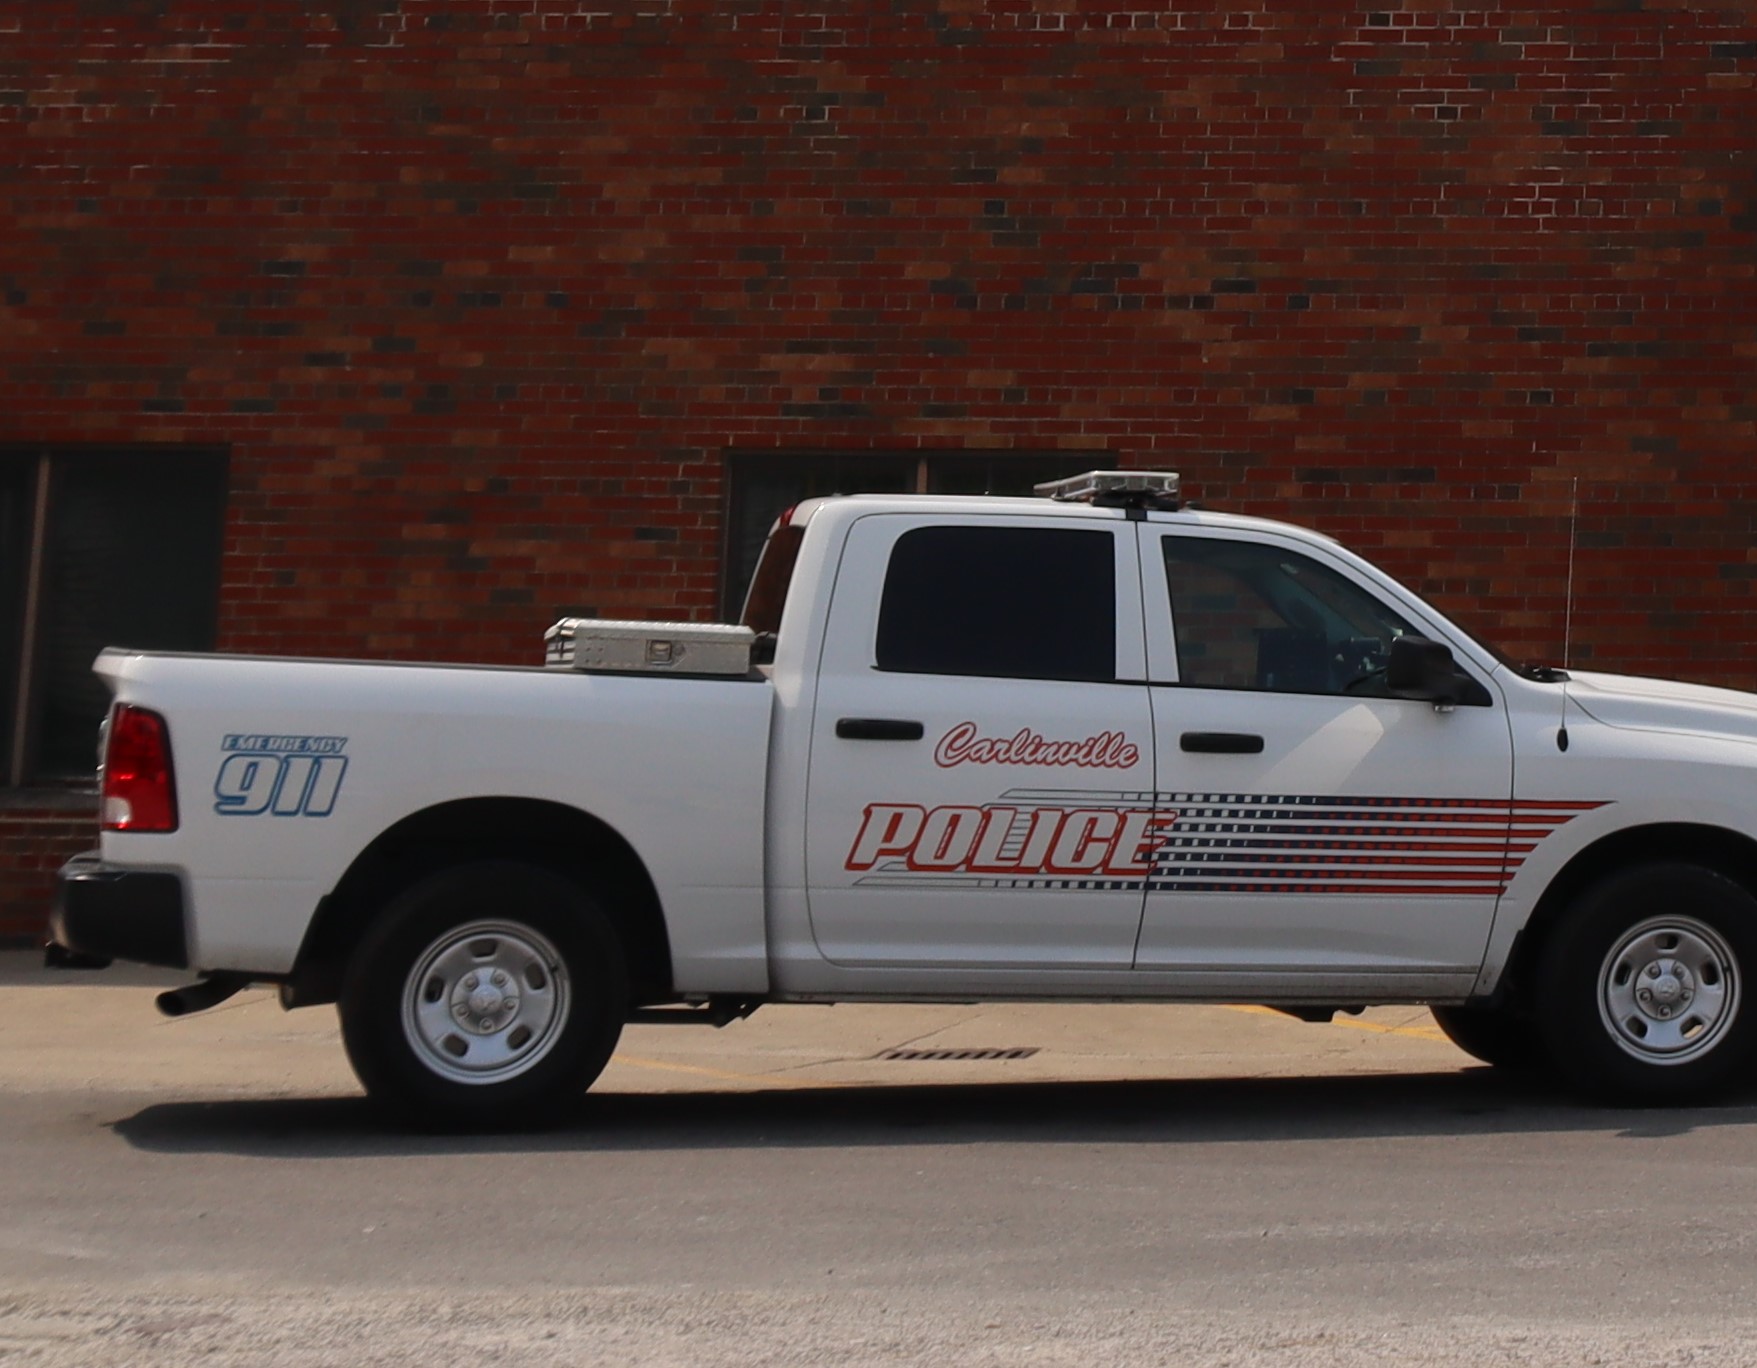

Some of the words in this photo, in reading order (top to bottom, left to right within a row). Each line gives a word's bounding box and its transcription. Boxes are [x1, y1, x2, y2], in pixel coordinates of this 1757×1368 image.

[934, 721, 1139, 768] Carlinville
[213, 753, 348, 817] 911
[844, 802, 1178, 876] POLICE
